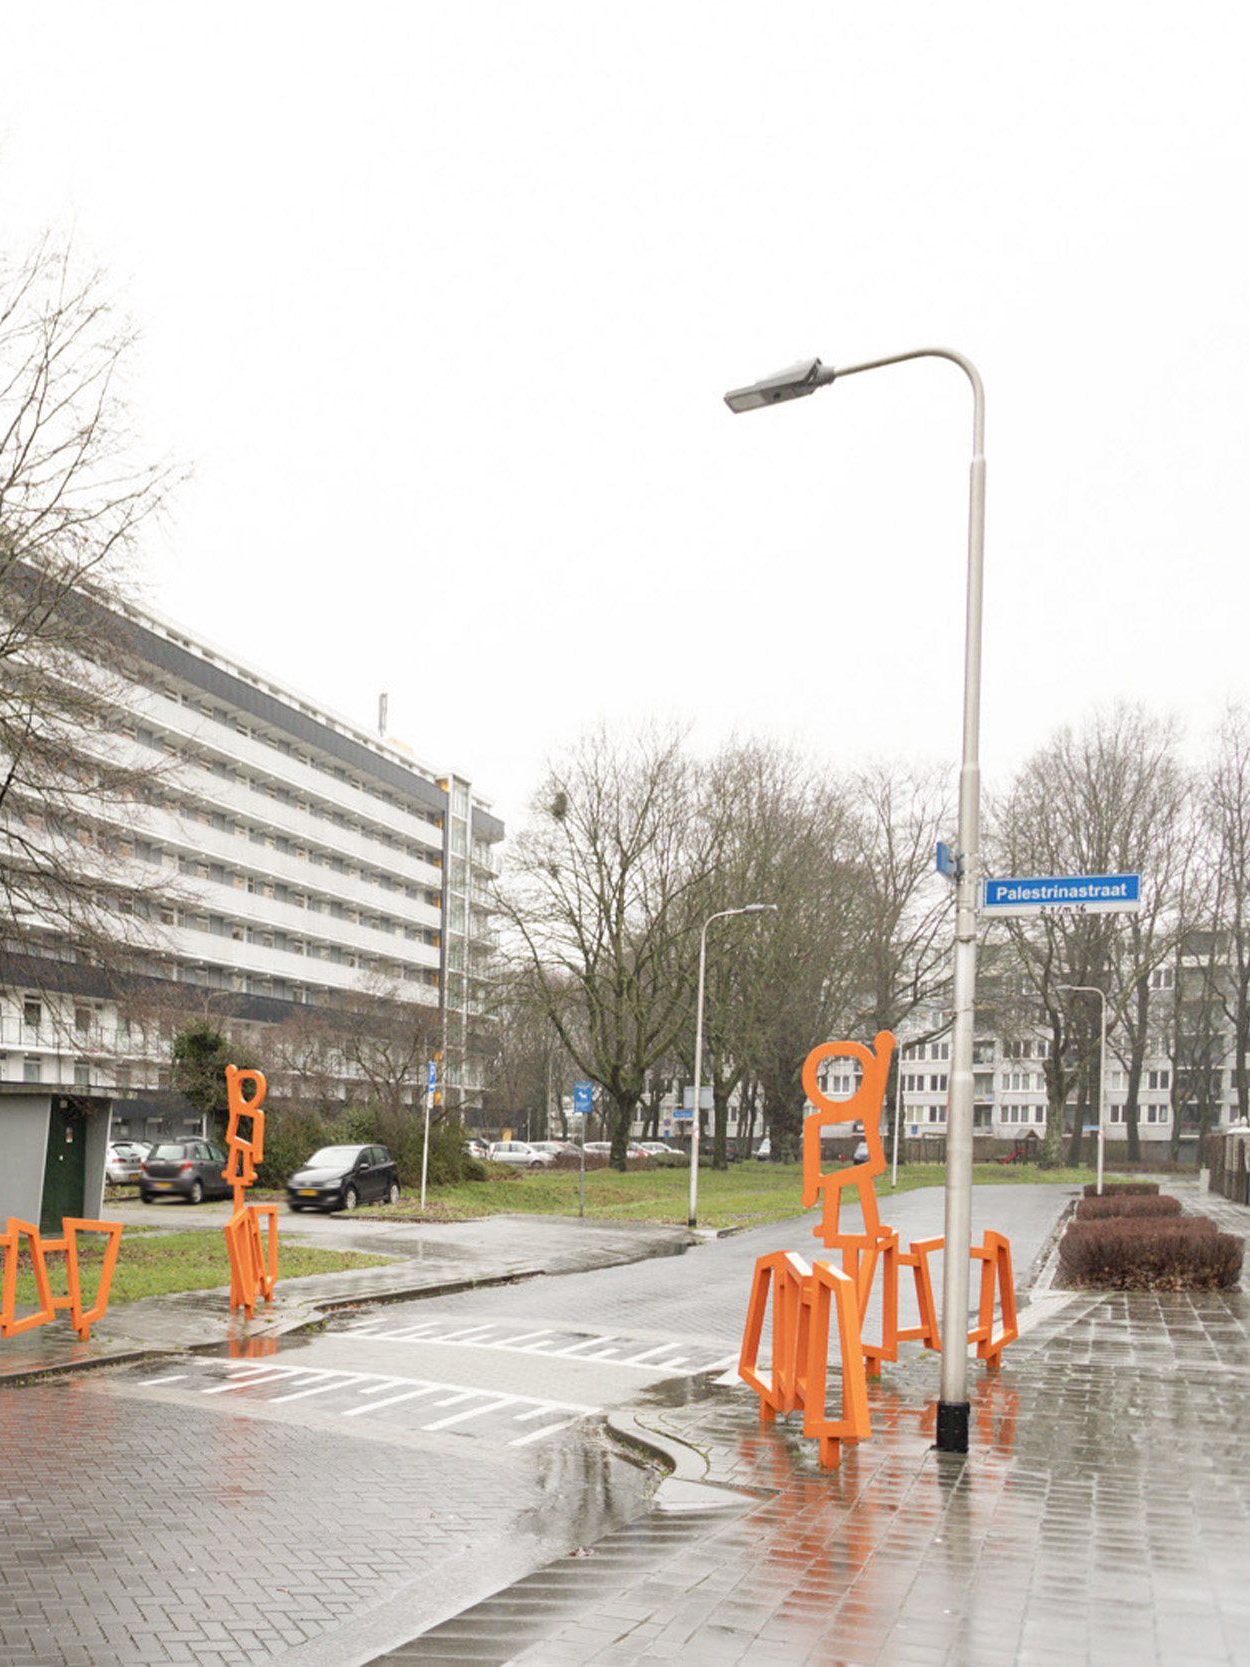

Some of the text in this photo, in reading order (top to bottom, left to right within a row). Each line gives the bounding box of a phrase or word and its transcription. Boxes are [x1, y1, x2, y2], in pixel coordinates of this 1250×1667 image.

[996, 883, 1127, 900] Palestrinastraat
[1039, 903, 1086, 914] 2 t/m 16
